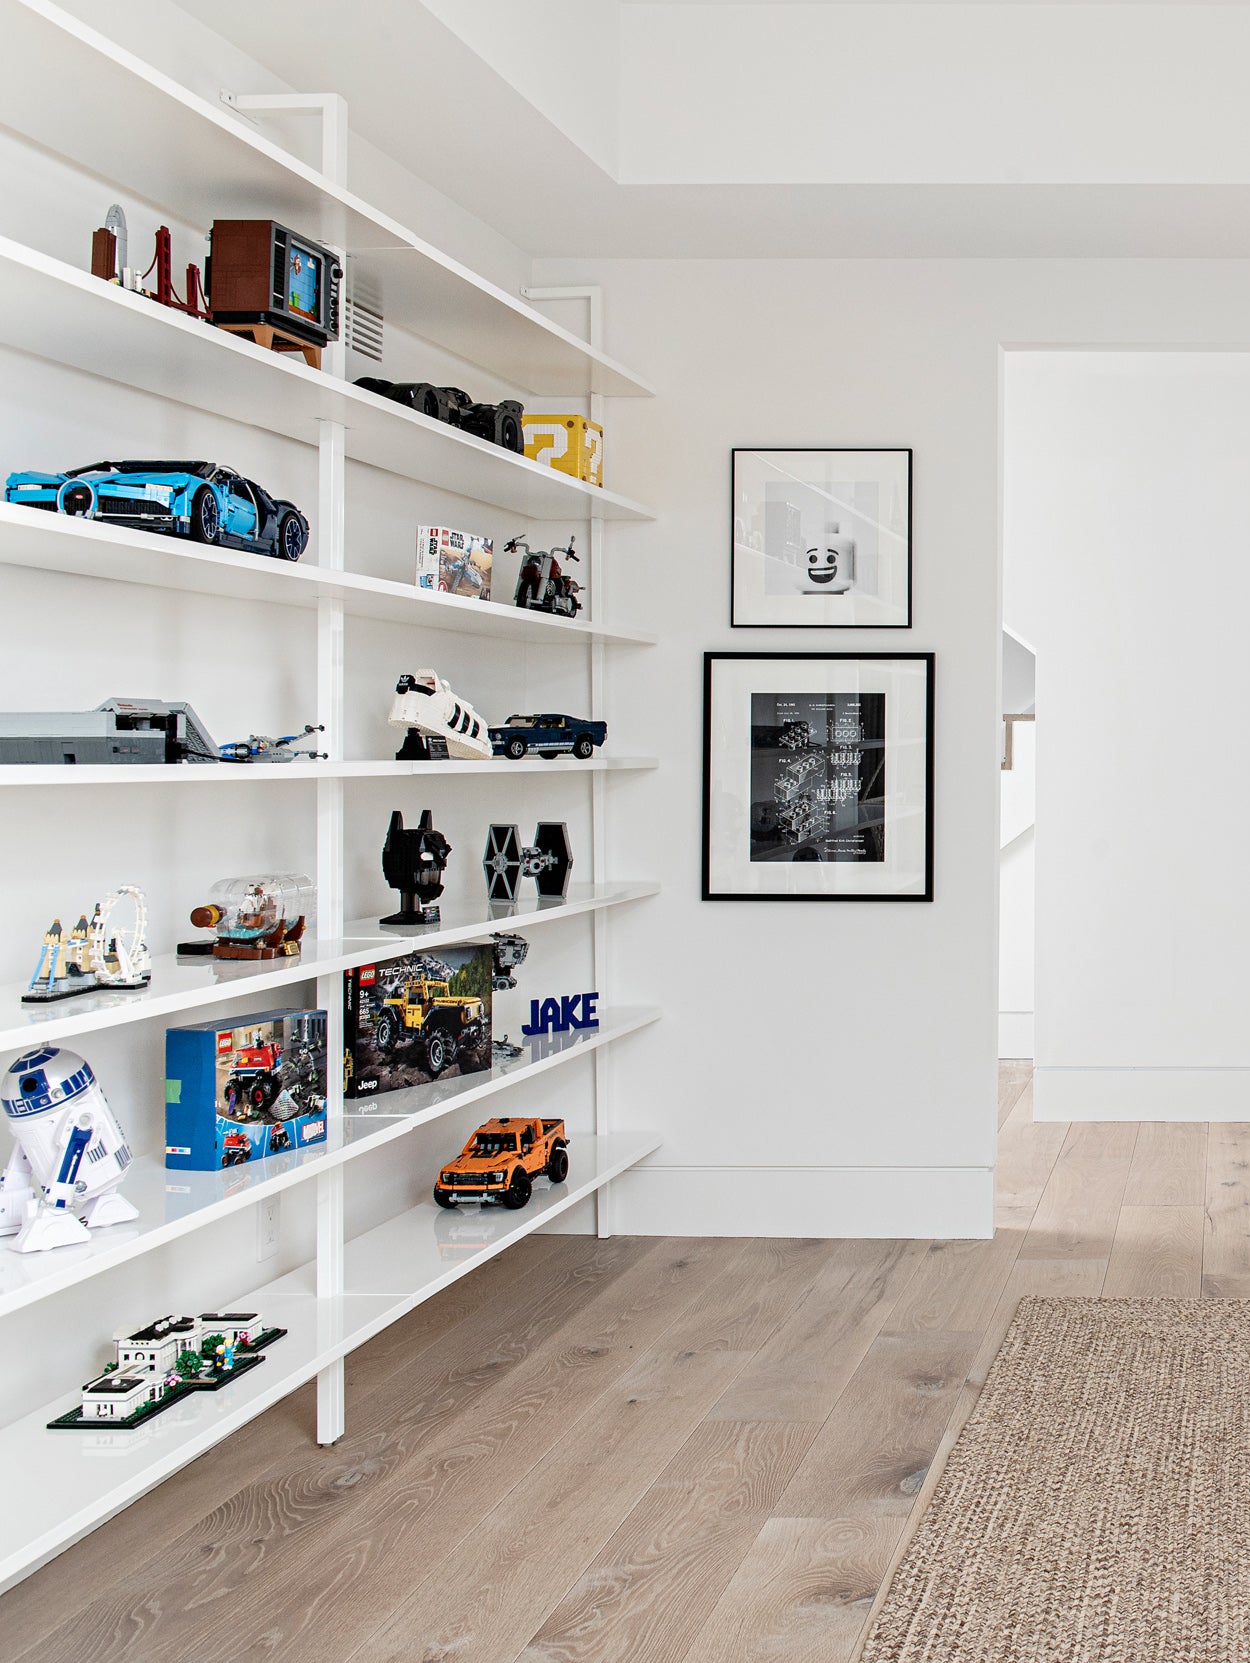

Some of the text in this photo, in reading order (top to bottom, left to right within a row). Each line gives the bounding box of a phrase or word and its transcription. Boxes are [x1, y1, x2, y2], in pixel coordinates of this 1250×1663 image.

[450, 532, 464, 541] STAR
[450, 540, 465, 549] WARS
[361, 970, 375, 980] LEGO
[379, 964, 423, 977] TECHNIC
[360, 990, 369, 998] 9+
[521, 992, 599, 1036] JAKE
[219, 1039, 231, 1047] LEGO
[358, 1080, 378, 1090] Jeep
